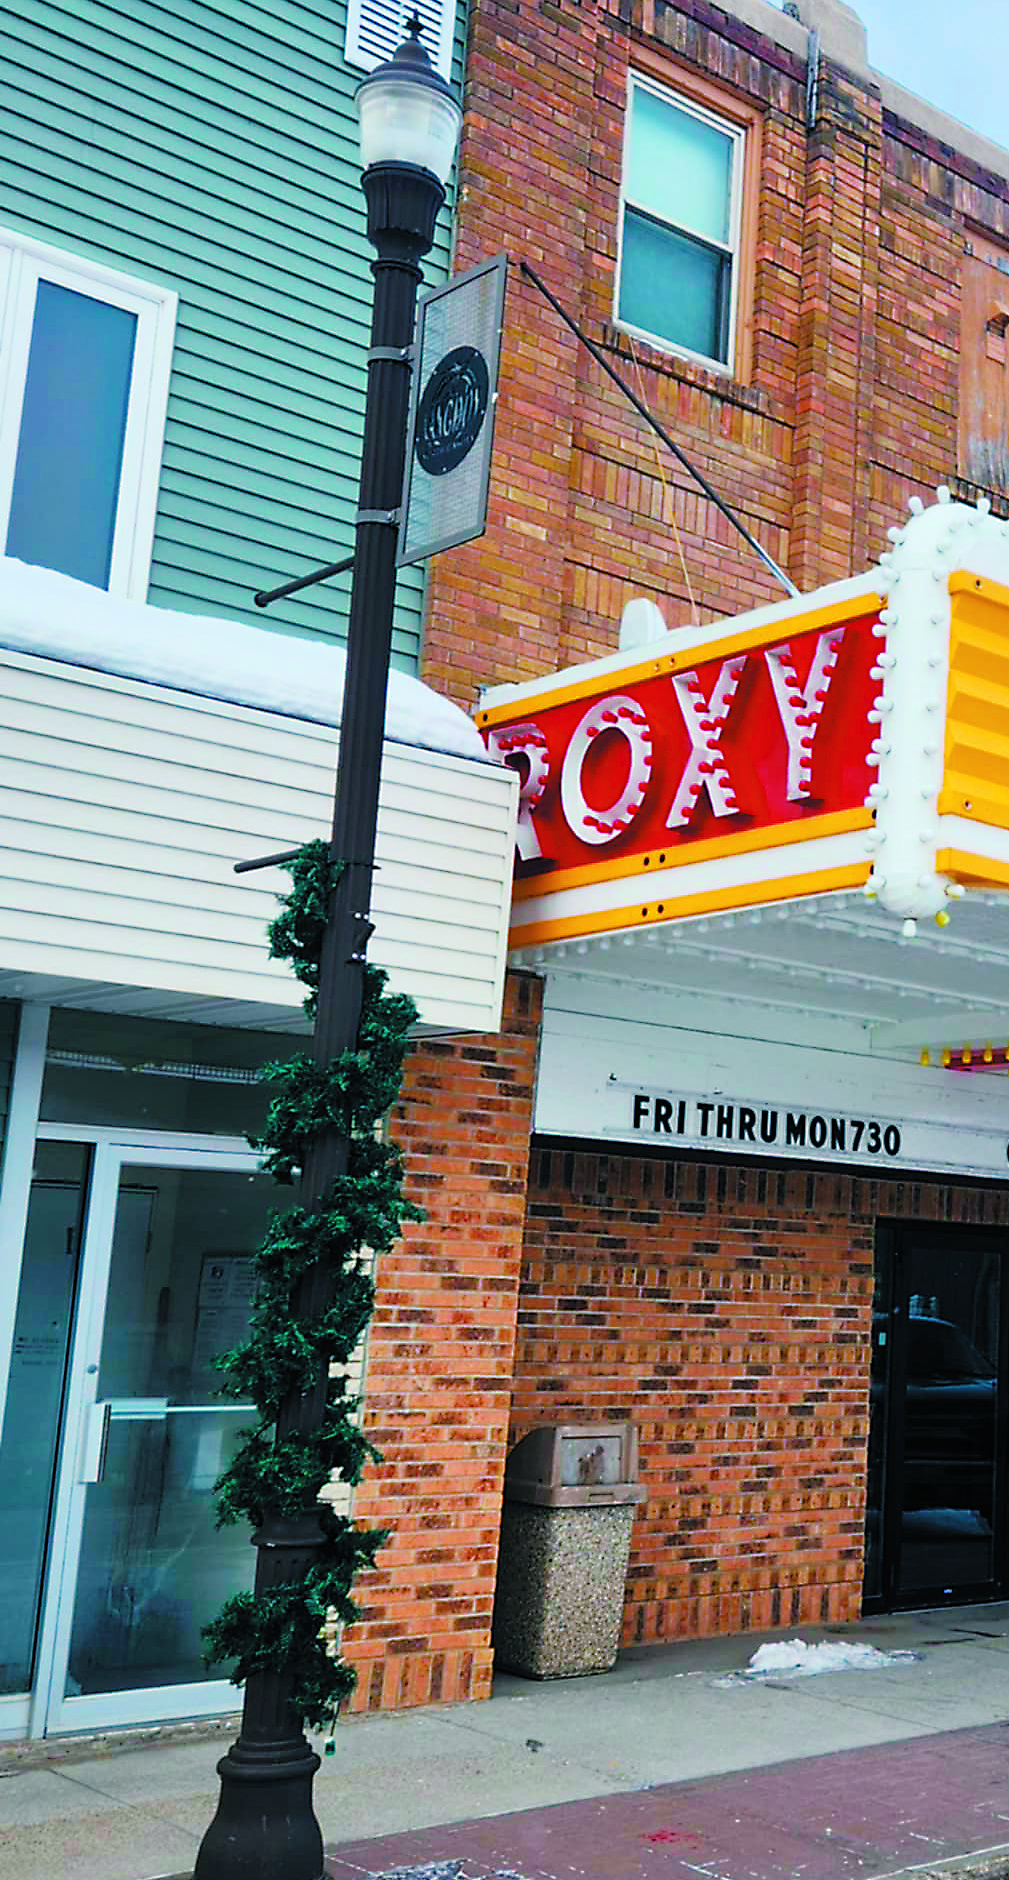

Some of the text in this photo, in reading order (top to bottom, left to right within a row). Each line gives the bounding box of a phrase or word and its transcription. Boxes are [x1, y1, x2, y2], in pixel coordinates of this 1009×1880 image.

[488, 627, 846, 862] ROXY
[633, 1094, 686, 1134] FRI
[697, 1102, 778, 1143] THRU
